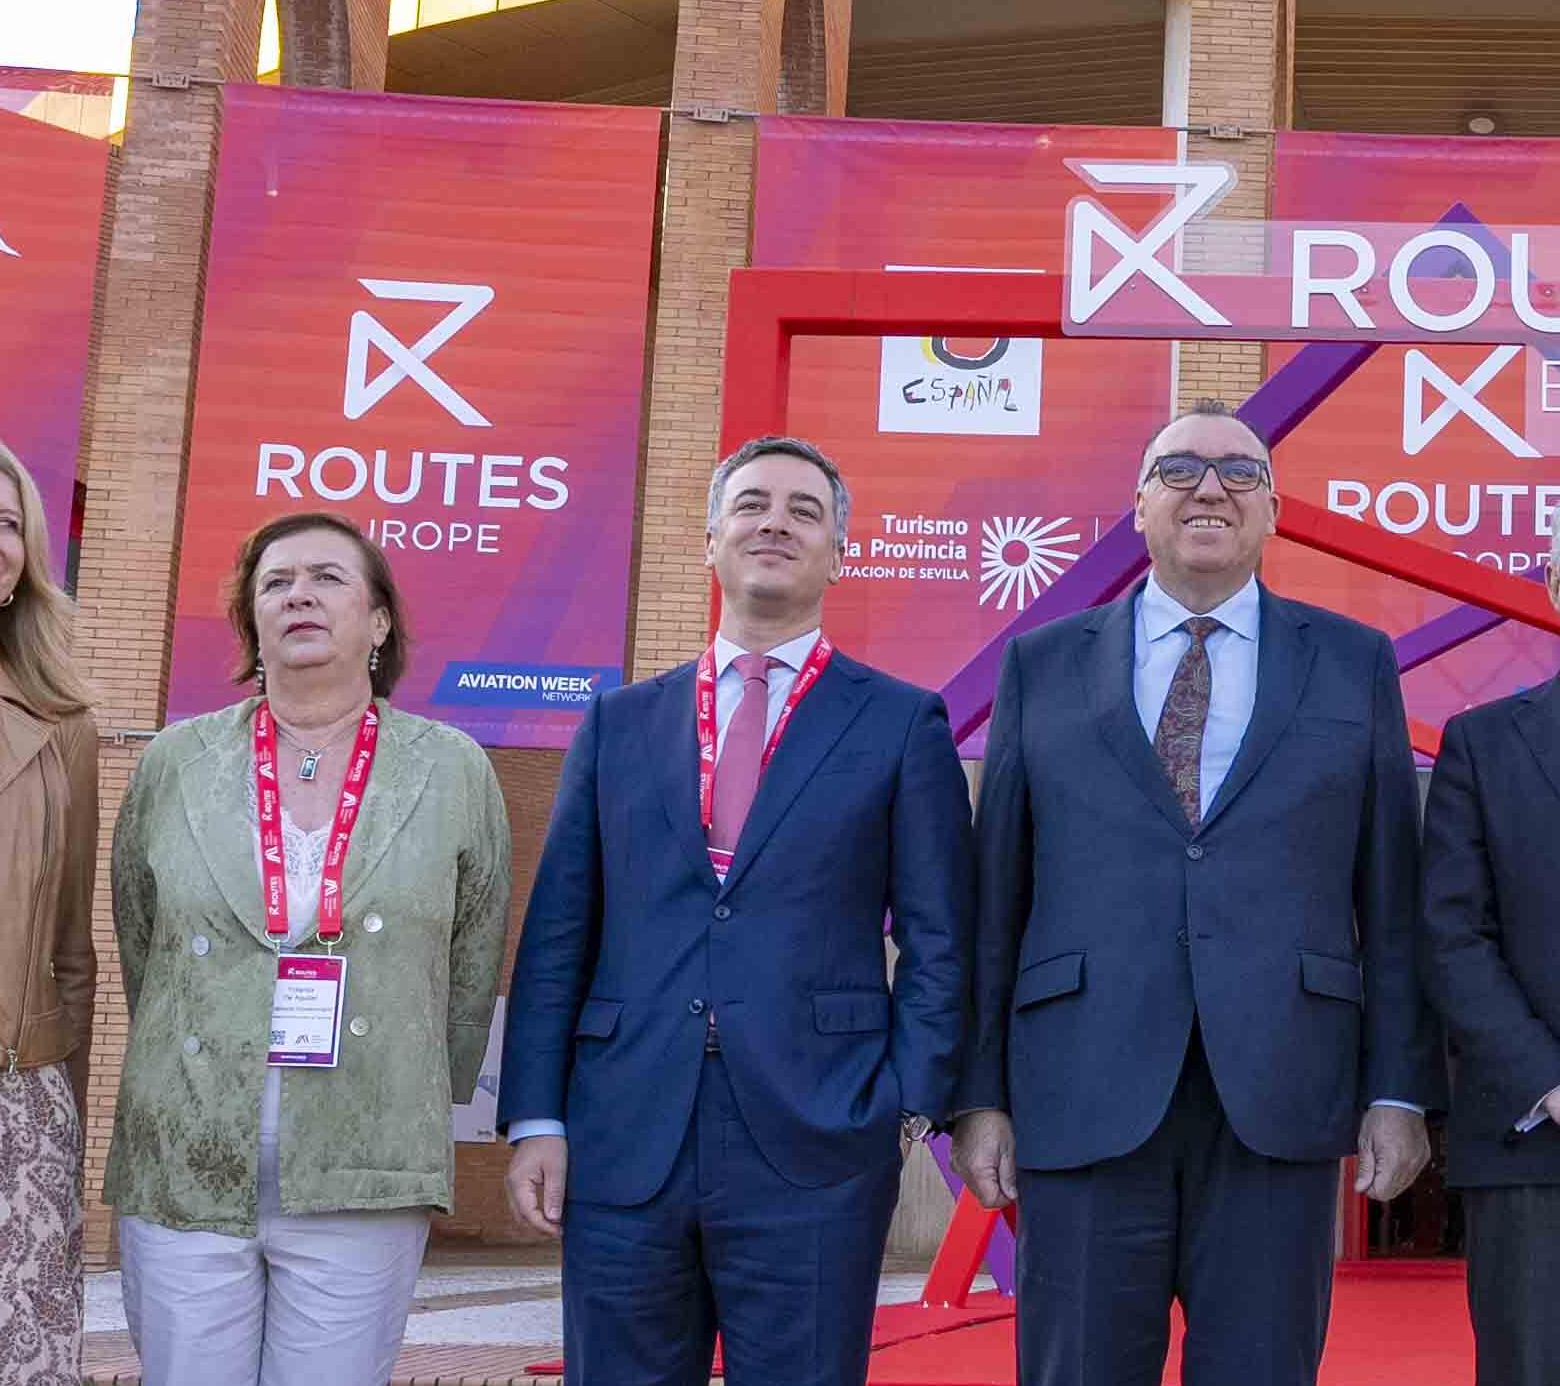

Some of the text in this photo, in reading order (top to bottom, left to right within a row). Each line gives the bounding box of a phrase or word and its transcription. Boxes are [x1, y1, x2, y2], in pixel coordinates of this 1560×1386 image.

[902, 371, 1019, 413] ESPAÑA
[255, 443, 570, 511] ROUTES
[881, 514, 969, 535] Turismo
[369, 519, 502, 553] ROPE
[870, 538, 968, 560] Provincia
[899, 567, 916, 580] DE
[920, 567, 970, 581] SEVILLA
[457, 673, 593, 692] AVIATION WEEK
[541, 692, 592, 703] NETWORK
